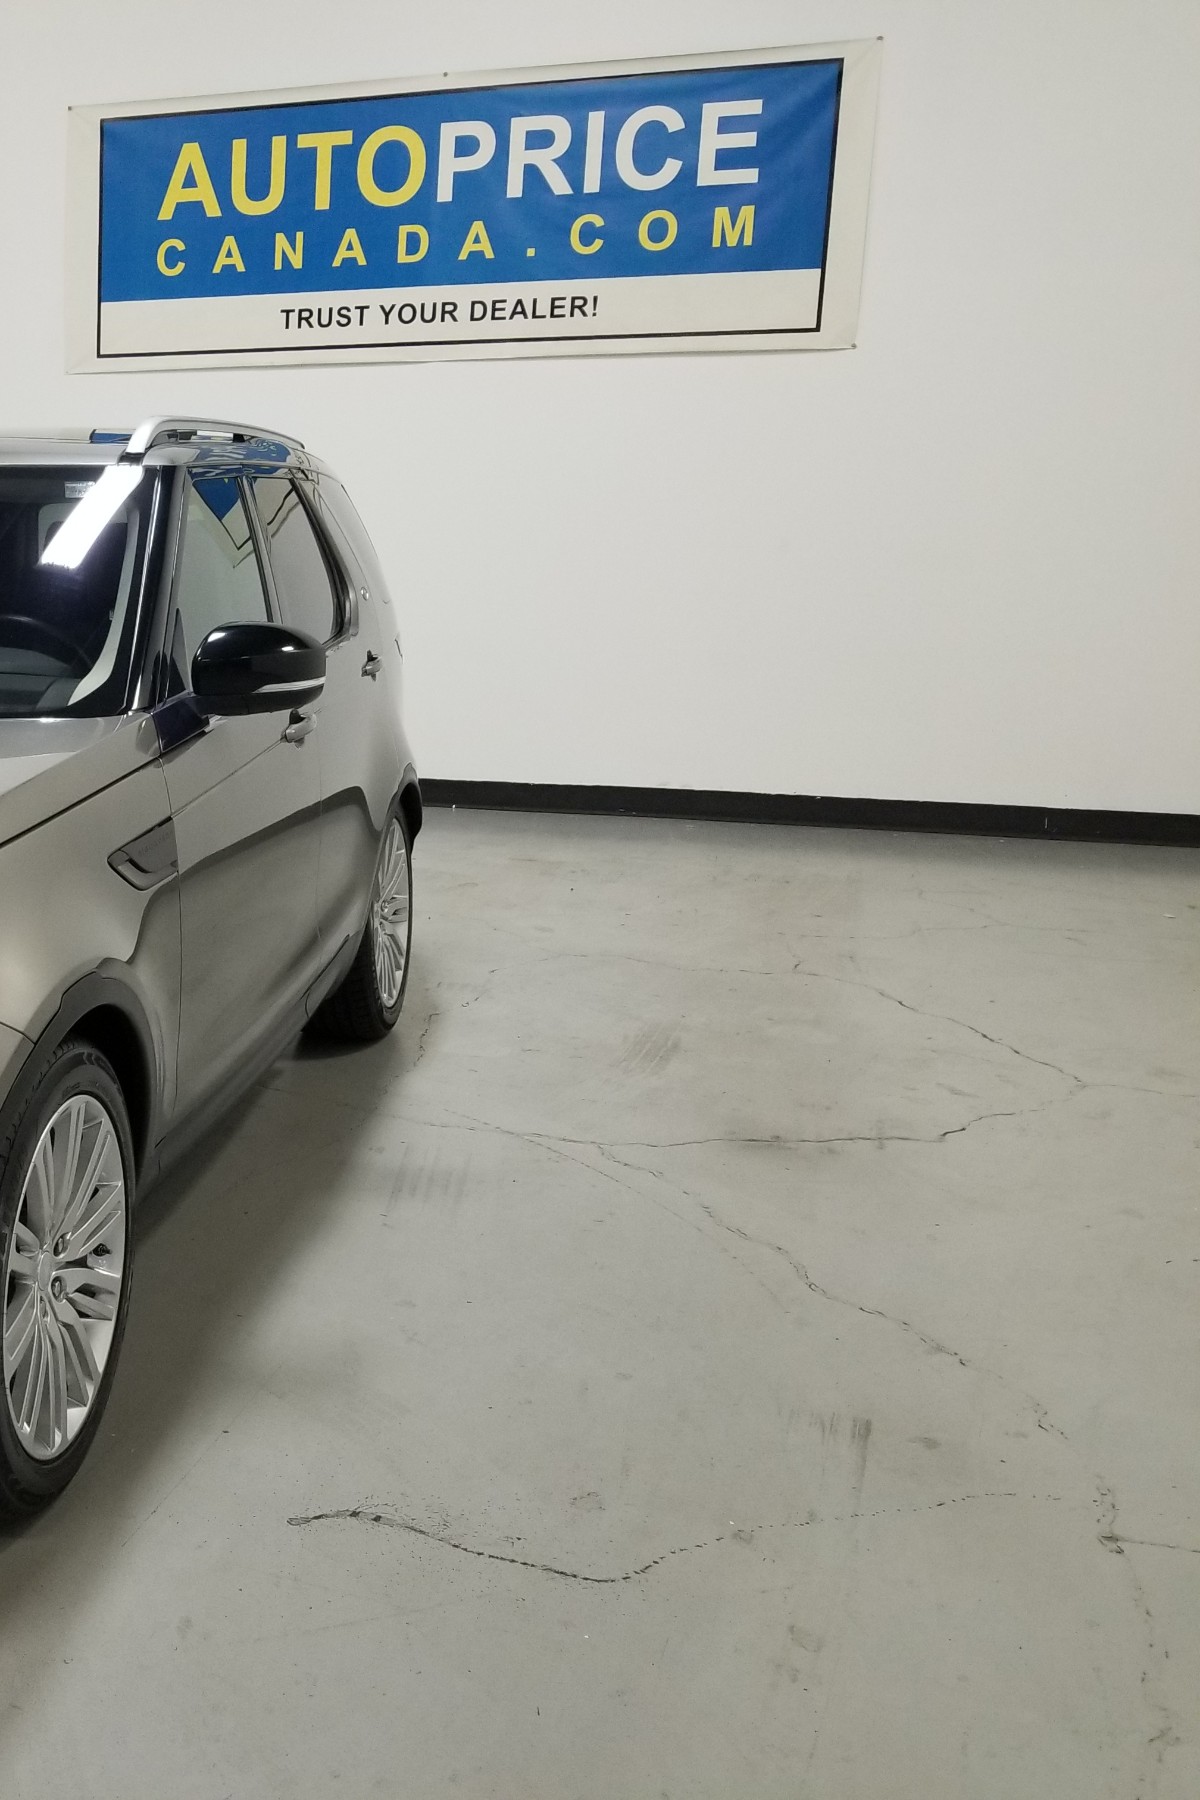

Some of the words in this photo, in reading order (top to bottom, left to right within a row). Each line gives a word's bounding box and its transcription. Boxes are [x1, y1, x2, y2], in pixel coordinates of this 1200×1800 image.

[158, 99, 763, 220] AUTOPRICE
[281, 305, 370, 330] TRUST
[379, 302, 459, 325] YOUR
[469, 296, 599, 322] DEALER!
